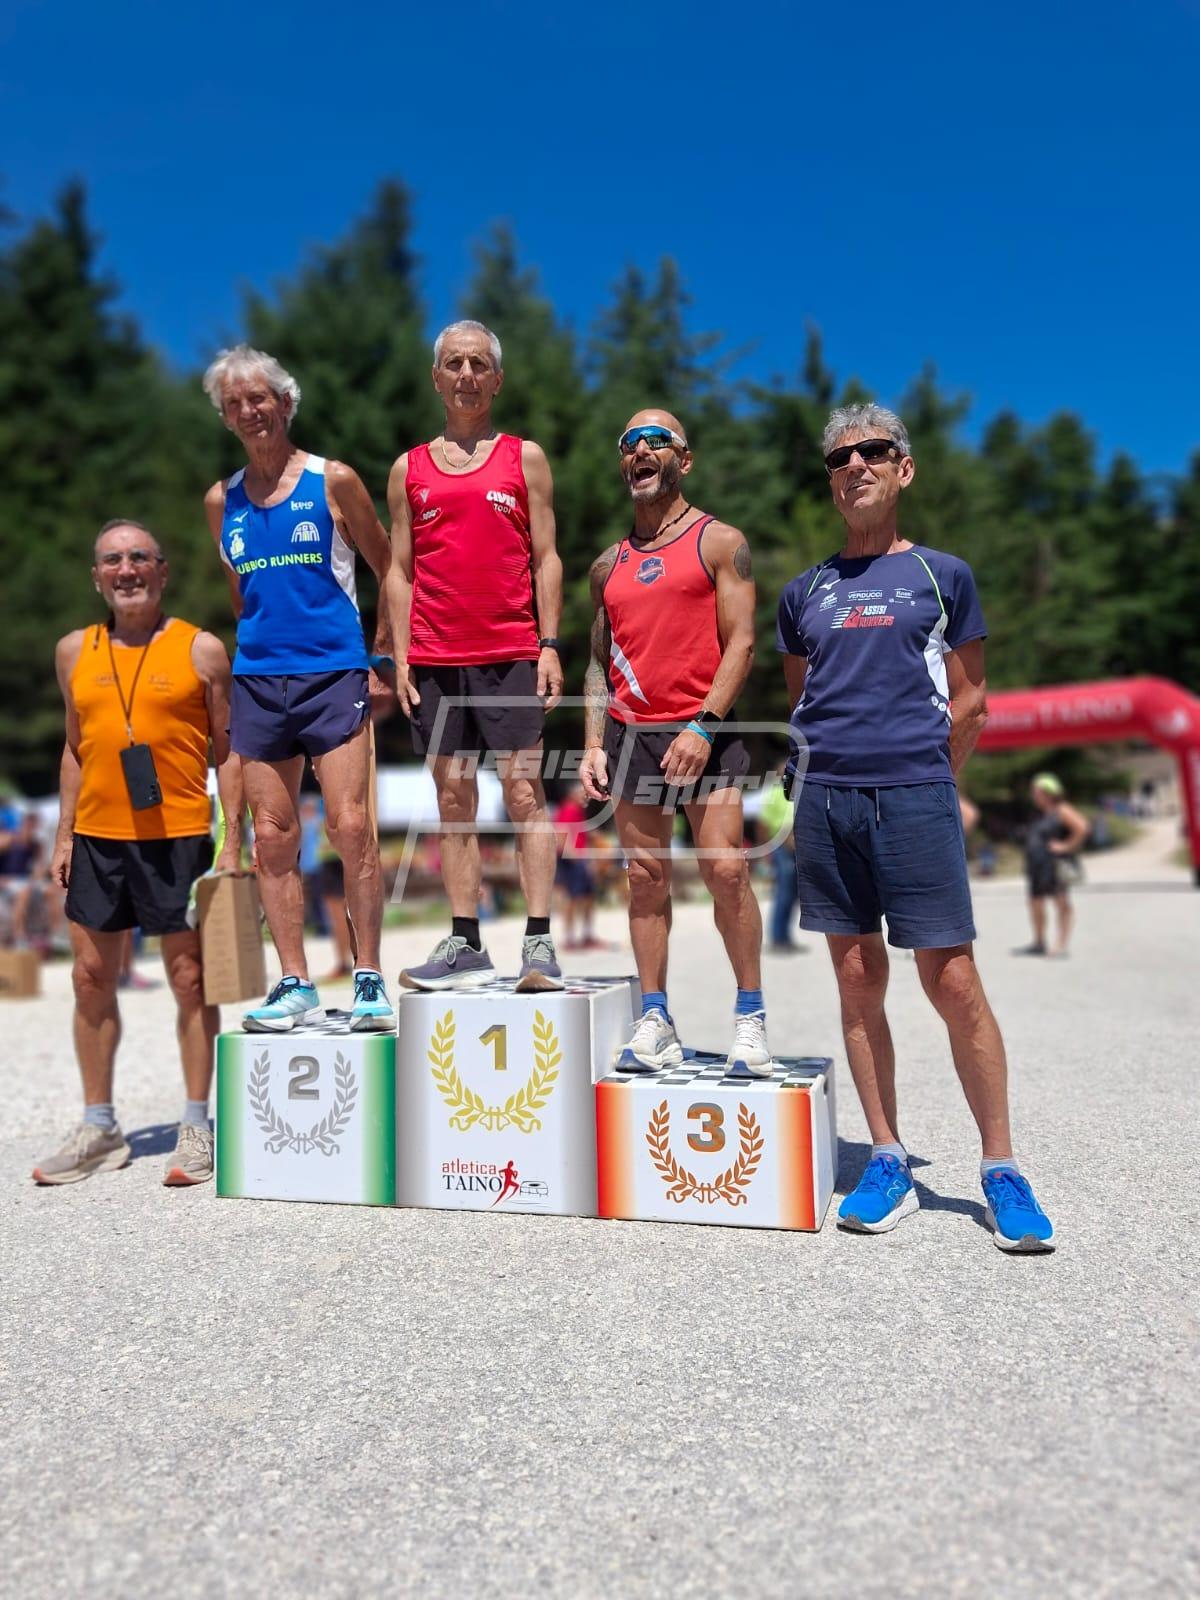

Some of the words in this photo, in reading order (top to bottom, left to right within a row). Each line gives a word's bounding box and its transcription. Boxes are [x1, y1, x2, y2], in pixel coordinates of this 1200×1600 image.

[493, 503, 511, 515] TODI
[270, 553, 323, 568] RUNNERS
[848, 591, 883, 600] VERDUCCI
[862, 605, 888, 616] ASSISI
[859, 616, 894, 628] RUNNERS
[478, 1024, 507, 1071] 1
[287, 1055, 321, 1101] 2
[686, 1102, 726, 1153] 3
[442, 1158, 497, 1175] atletica
[442, 1174, 503, 1193] TAINO
